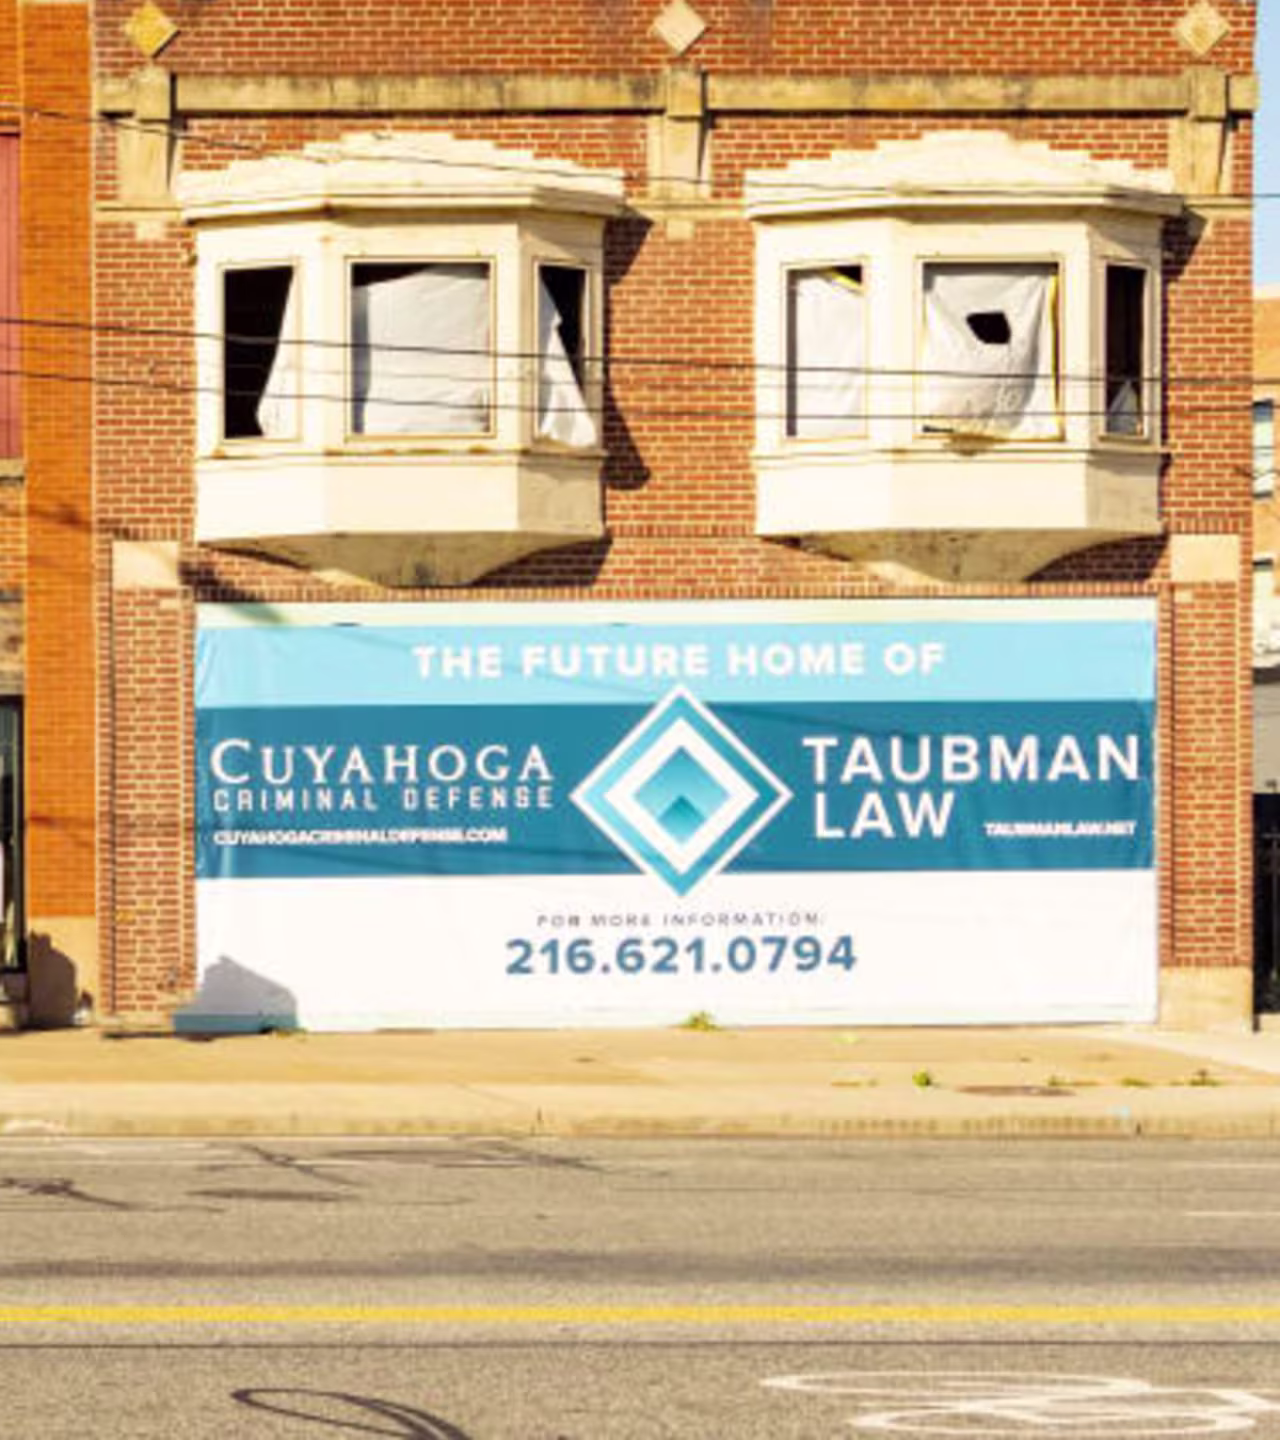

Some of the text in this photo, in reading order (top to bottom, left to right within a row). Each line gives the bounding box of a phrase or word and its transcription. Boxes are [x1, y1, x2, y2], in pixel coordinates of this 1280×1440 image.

[412, 643, 945, 679] THE FUTURE HOME OF
[210, 739, 555, 785] CUYAHOGA
[803, 735, 1140, 784] TAUBMAN
[213, 786, 554, 812] CRIMINAL DEFENSE
[814, 792, 955, 838] LAW
[537, 915, 580, 927] FOR
[591, 914, 651, 926] MORE
[505, 936, 856, 975] 216.621.0794
